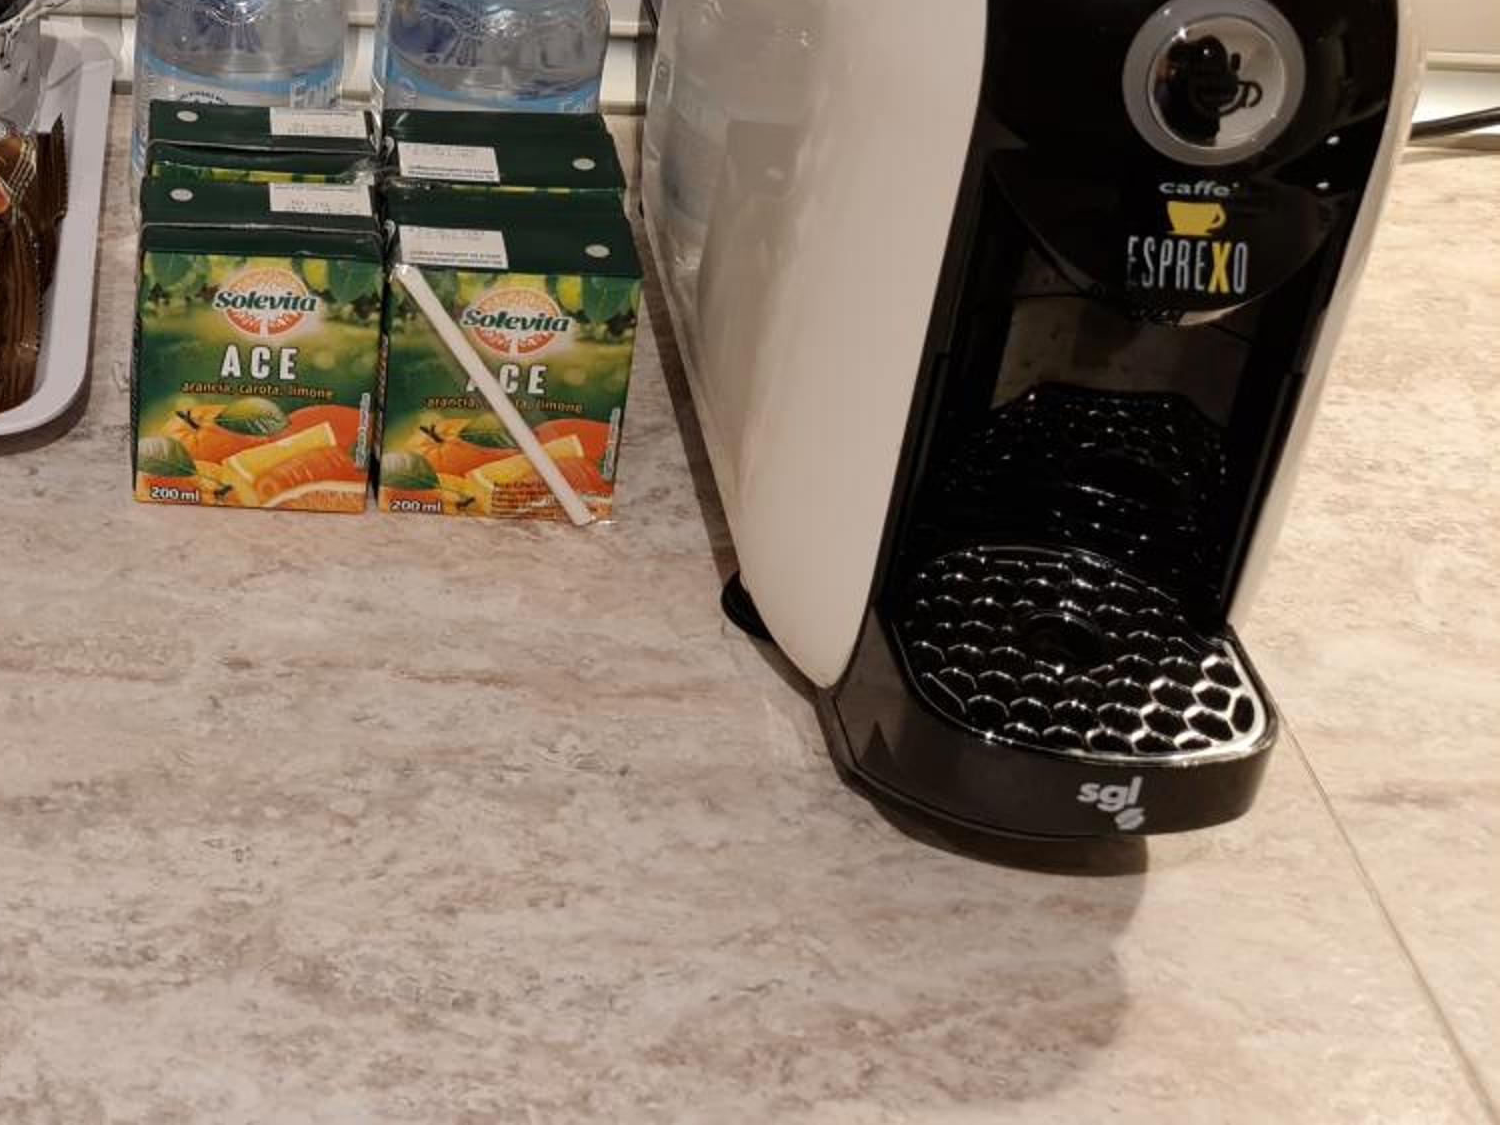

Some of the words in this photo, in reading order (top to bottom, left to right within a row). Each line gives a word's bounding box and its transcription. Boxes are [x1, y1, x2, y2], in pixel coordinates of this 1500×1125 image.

[1126, 235, 1249, 295] ESPREXO
[214, 290, 318, 312] Solevita
[462, 309, 572, 333] Solevita
[220, 343, 299, 381] ACE
[1075, 775, 1144, 812] sgl
